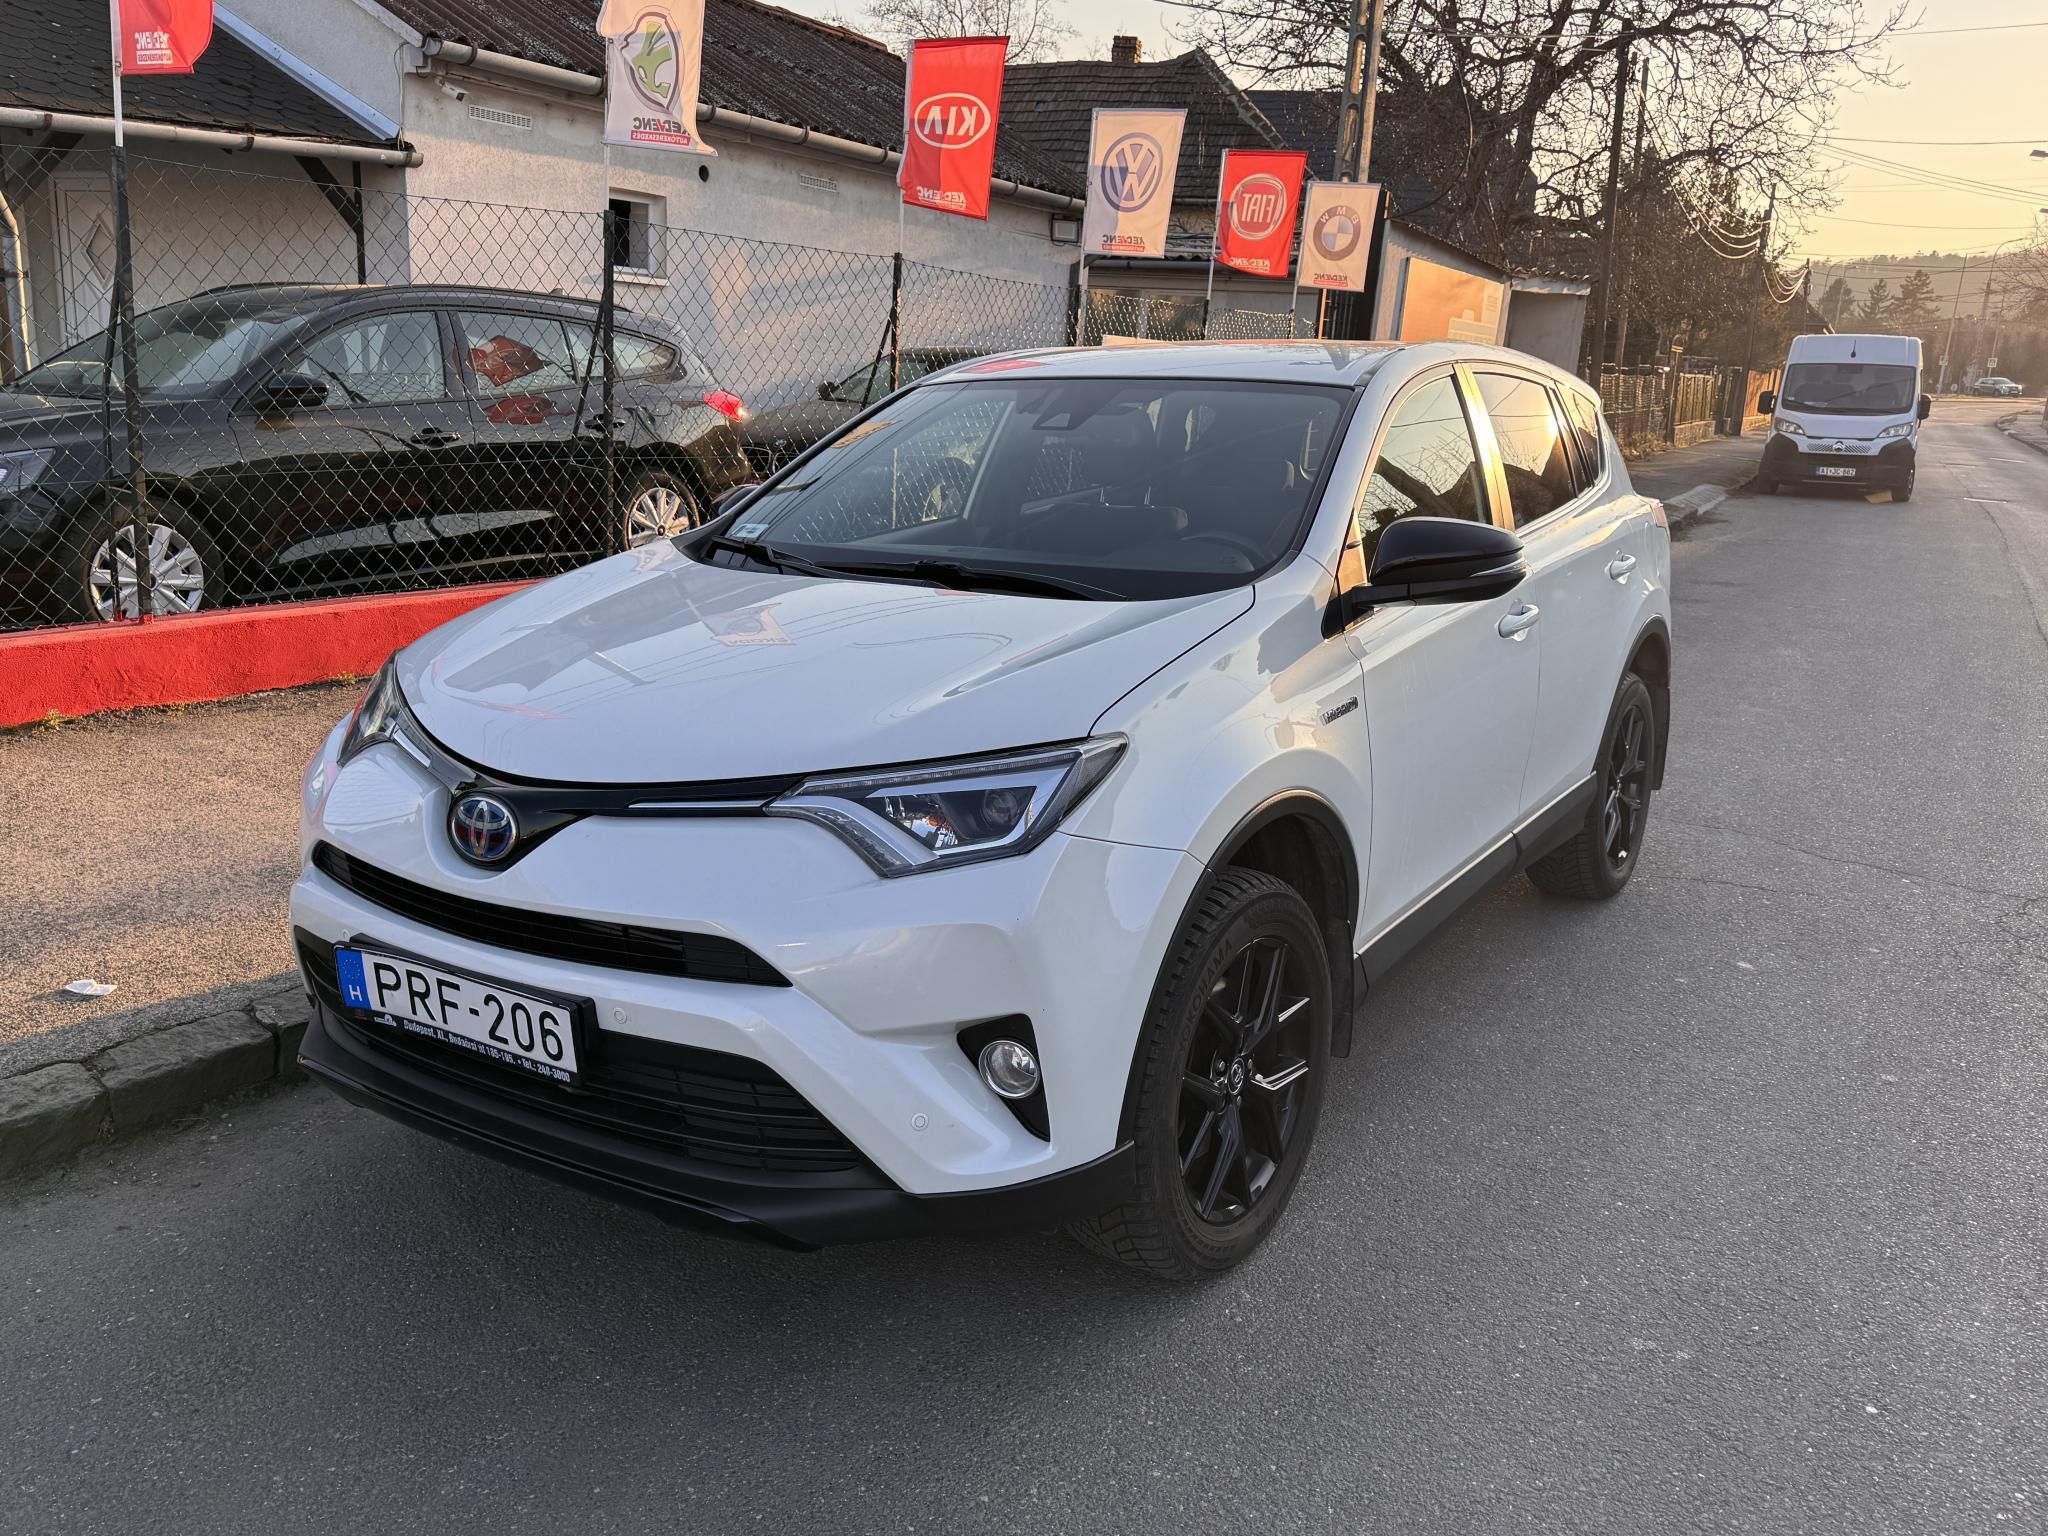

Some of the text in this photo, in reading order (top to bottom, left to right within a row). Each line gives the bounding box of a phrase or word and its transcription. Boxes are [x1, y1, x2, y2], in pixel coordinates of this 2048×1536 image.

[348, 961, 563, 1062] H PRF-206
[1175, 939, 1233, 1060] YOKOHAMA
